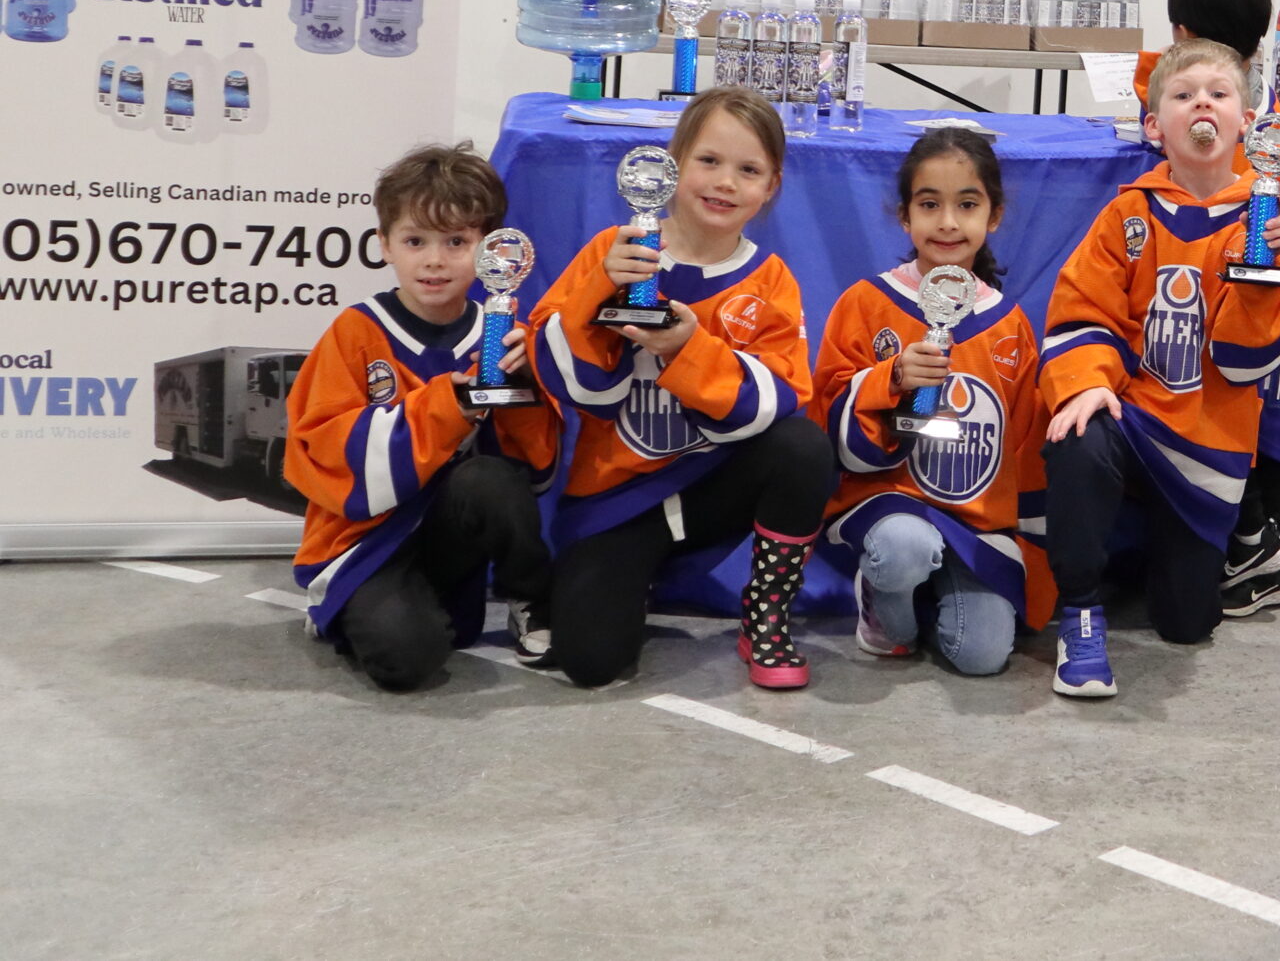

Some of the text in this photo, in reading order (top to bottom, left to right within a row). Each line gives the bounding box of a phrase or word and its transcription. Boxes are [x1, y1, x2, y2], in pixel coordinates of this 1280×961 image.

[167, 5, 205, 24] WATER
[2, 180, 83, 200] owned,
[89, 181, 162, 204] Selling
[168, 183, 267, 203] Canadian
[274, 187, 332, 205] made
[0, 276, 339, 313] www.puretap.ca
[15, 426, 45, 439] and
[50, 426, 132, 439] Wholesale
